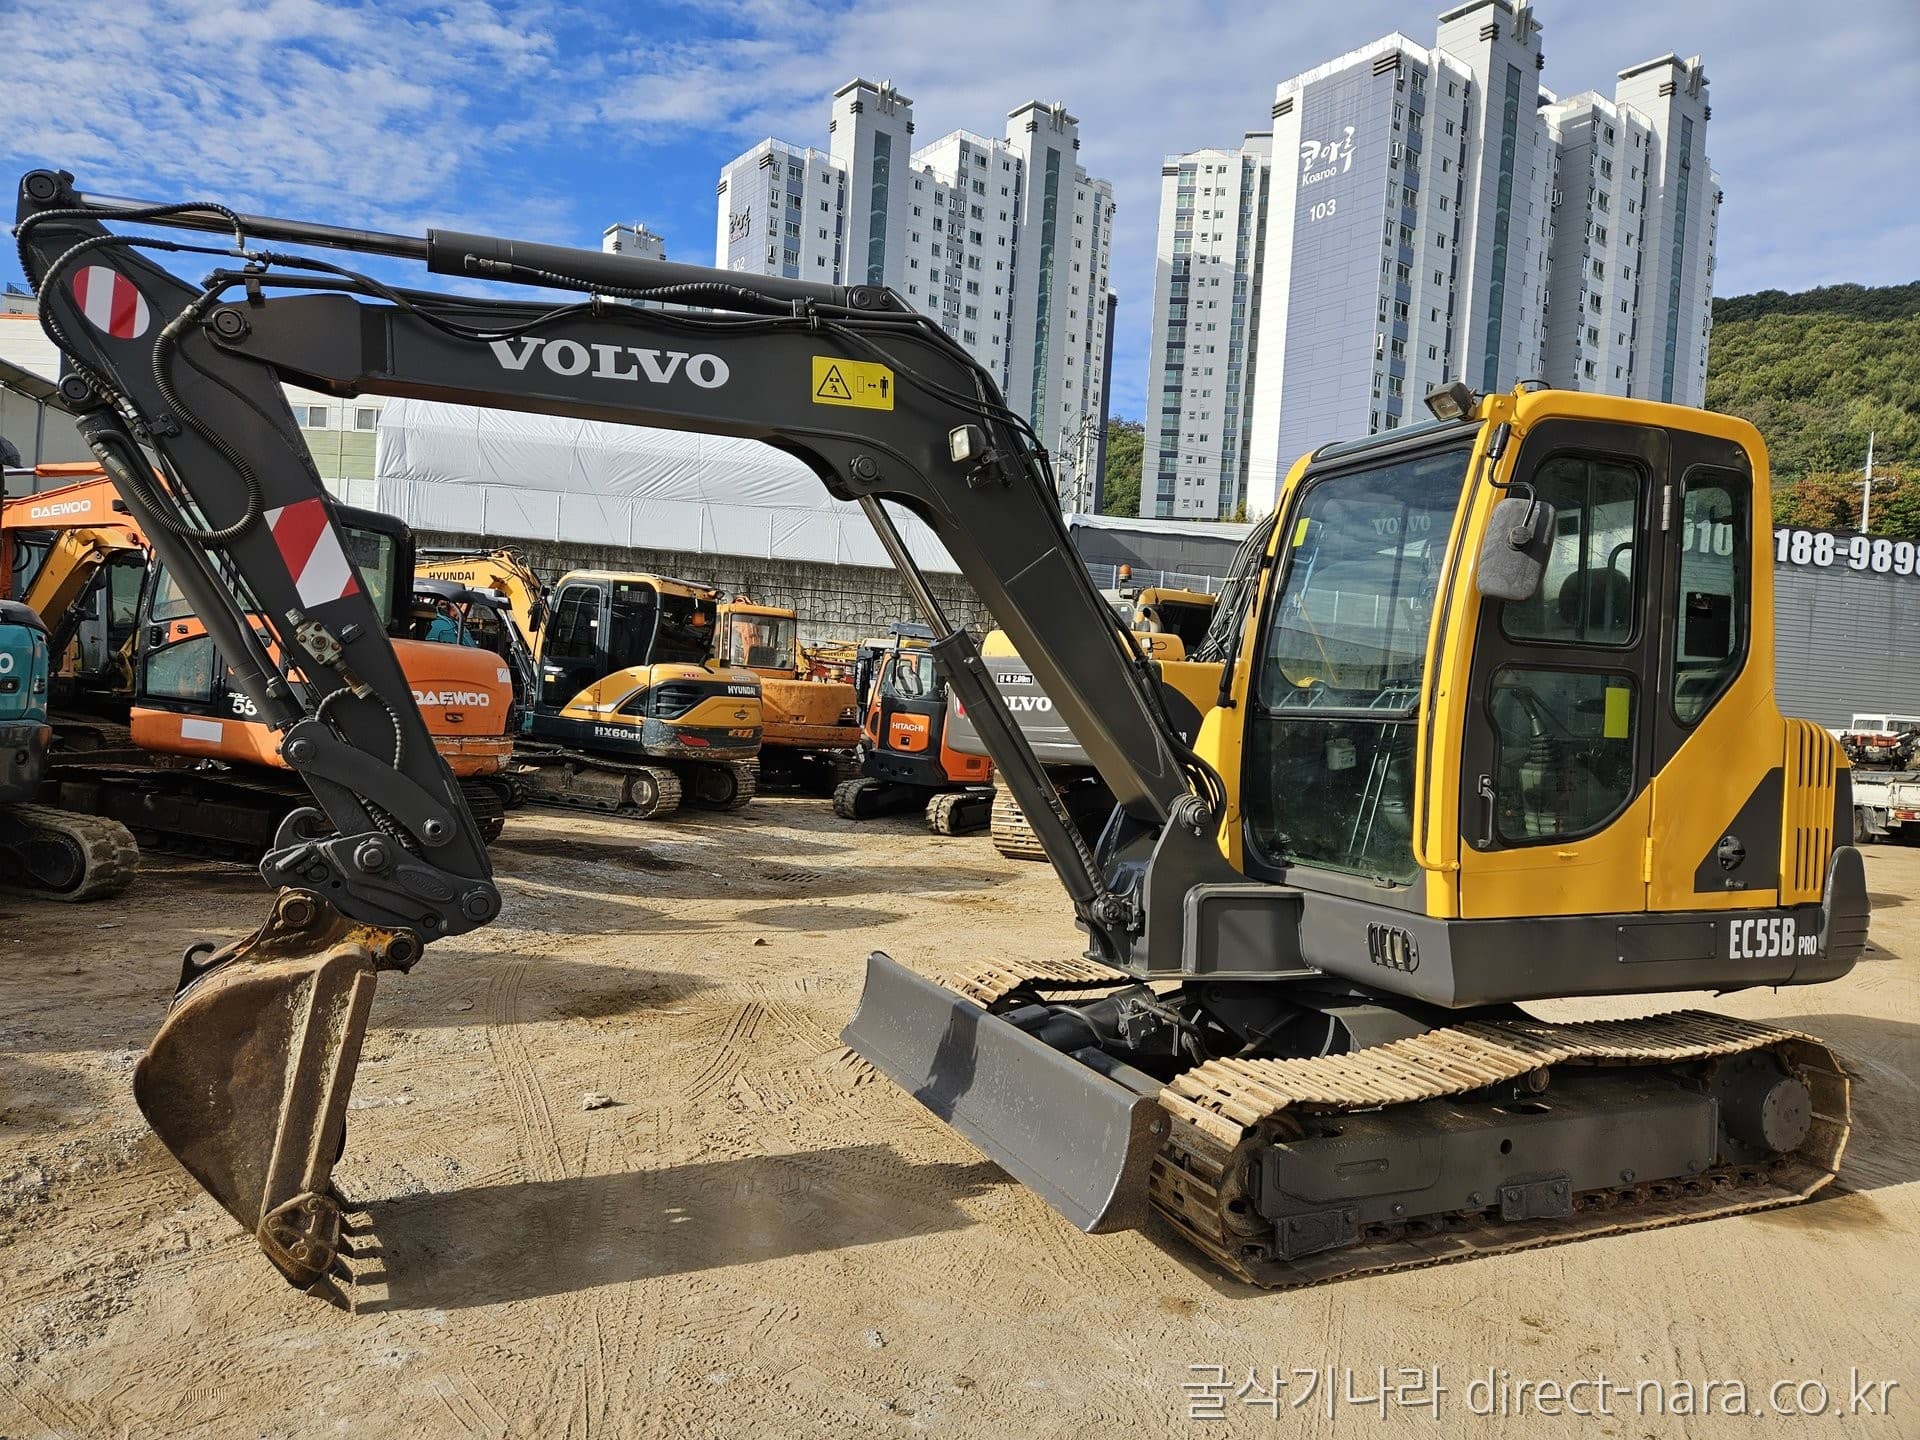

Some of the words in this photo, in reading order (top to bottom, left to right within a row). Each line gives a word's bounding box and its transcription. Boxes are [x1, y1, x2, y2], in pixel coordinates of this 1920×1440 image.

[1302, 167, 1337, 187] Koaroo
[1310, 199, 1336, 221] 103
[478, 333, 730, 389] VOLVO
[31, 500, 92, 518] DAEWOO
[1371, 515, 1432, 535] VOVO
[1774, 528, 1920, 576] 188-989
[429, 571, 475, 581] HYUNDAI
[412, 690, 490, 707] DAEWOO
[727, 685, 756, 695] HYUNDAI
[232, 698, 258, 716] 55
[1002, 695, 1053, 712] LVO
[892, 722, 924, 732] HITACHI
[1729, 918, 1796, 960] EC55B
[1797, 935, 1817, 956] PRO
